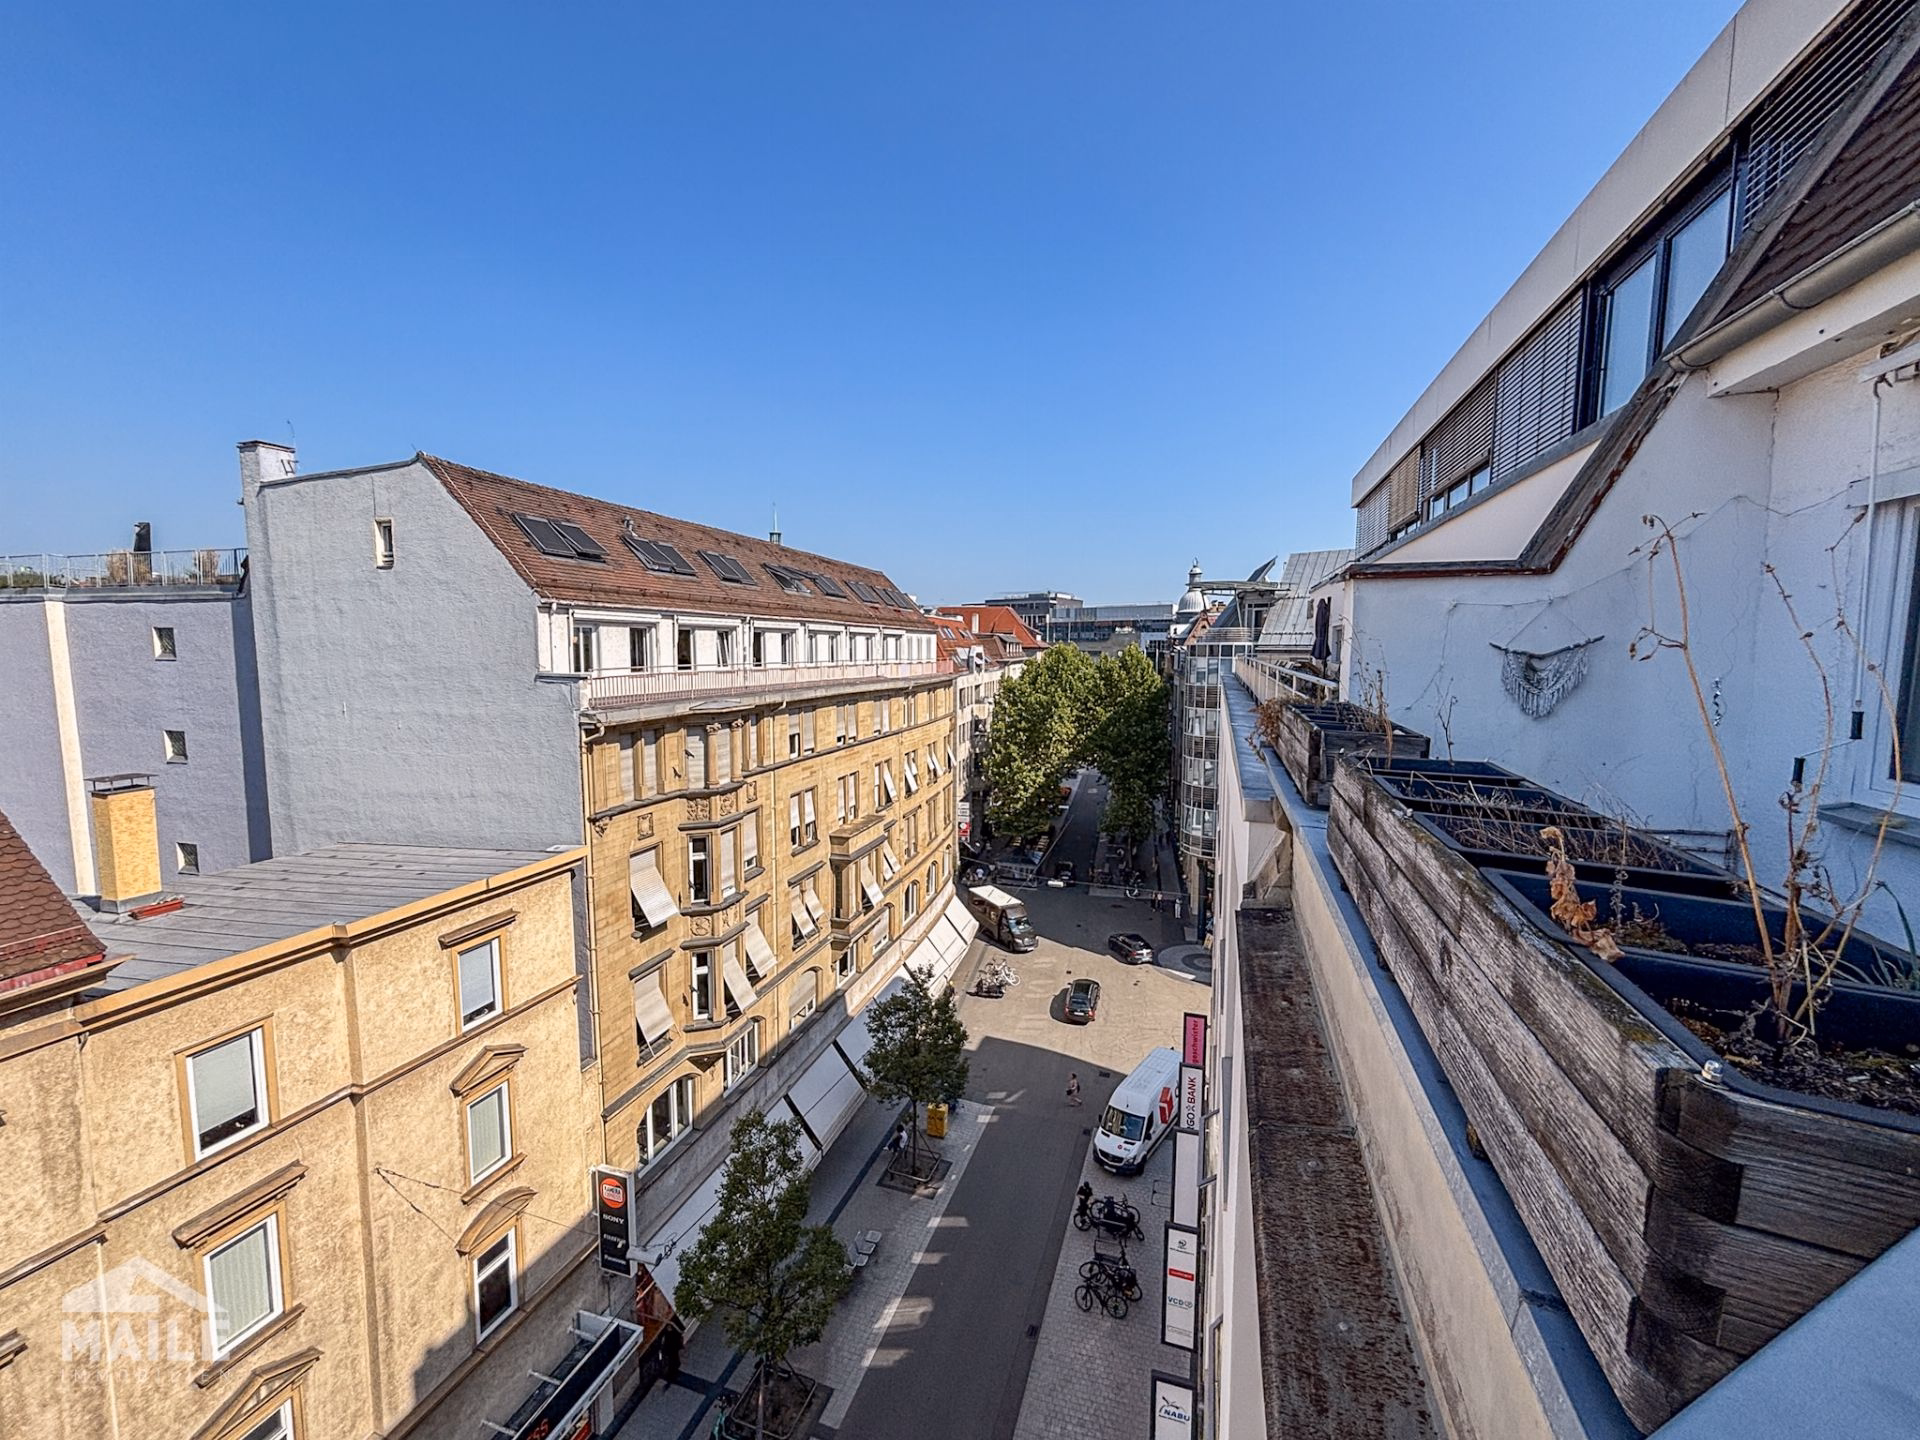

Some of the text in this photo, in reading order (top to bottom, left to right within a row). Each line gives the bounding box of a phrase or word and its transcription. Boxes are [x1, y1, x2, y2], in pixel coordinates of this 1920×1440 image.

[1188, 1076, 1197, 1104] BANK
[603, 1213, 624, 1224] SONY
[1167, 1295, 1184, 1306] VCD
[1163, 1408, 1190, 1422] NABU
